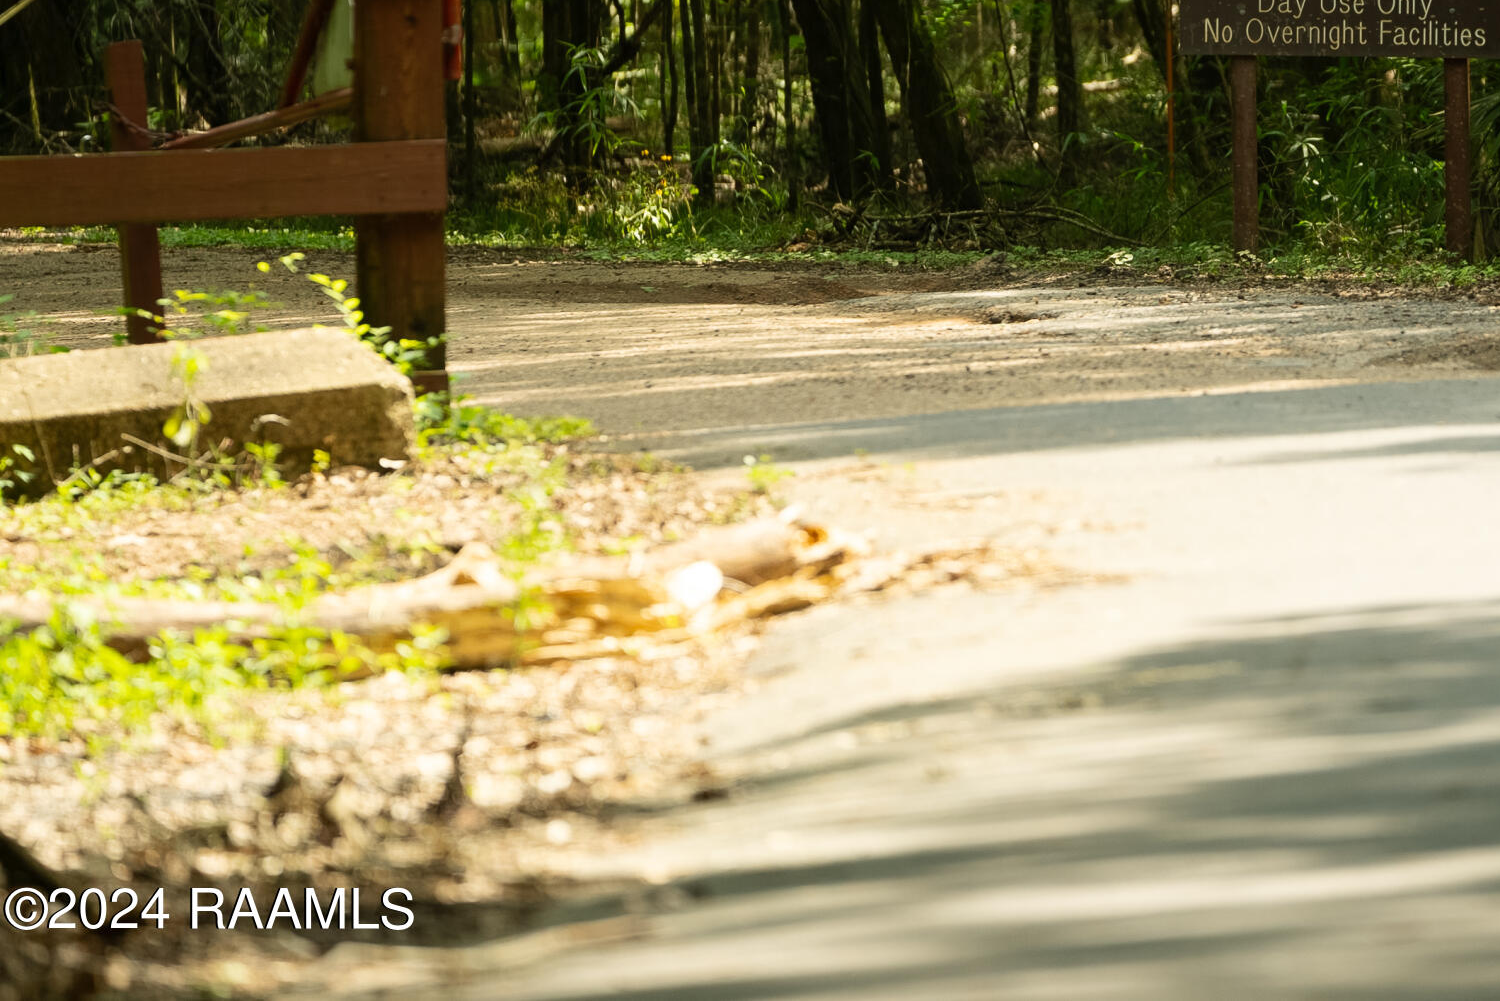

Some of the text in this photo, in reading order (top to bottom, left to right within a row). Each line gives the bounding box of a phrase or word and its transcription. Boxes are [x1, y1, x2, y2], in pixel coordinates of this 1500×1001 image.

[1203, 17, 1487, 50] No Overnight Facilities
